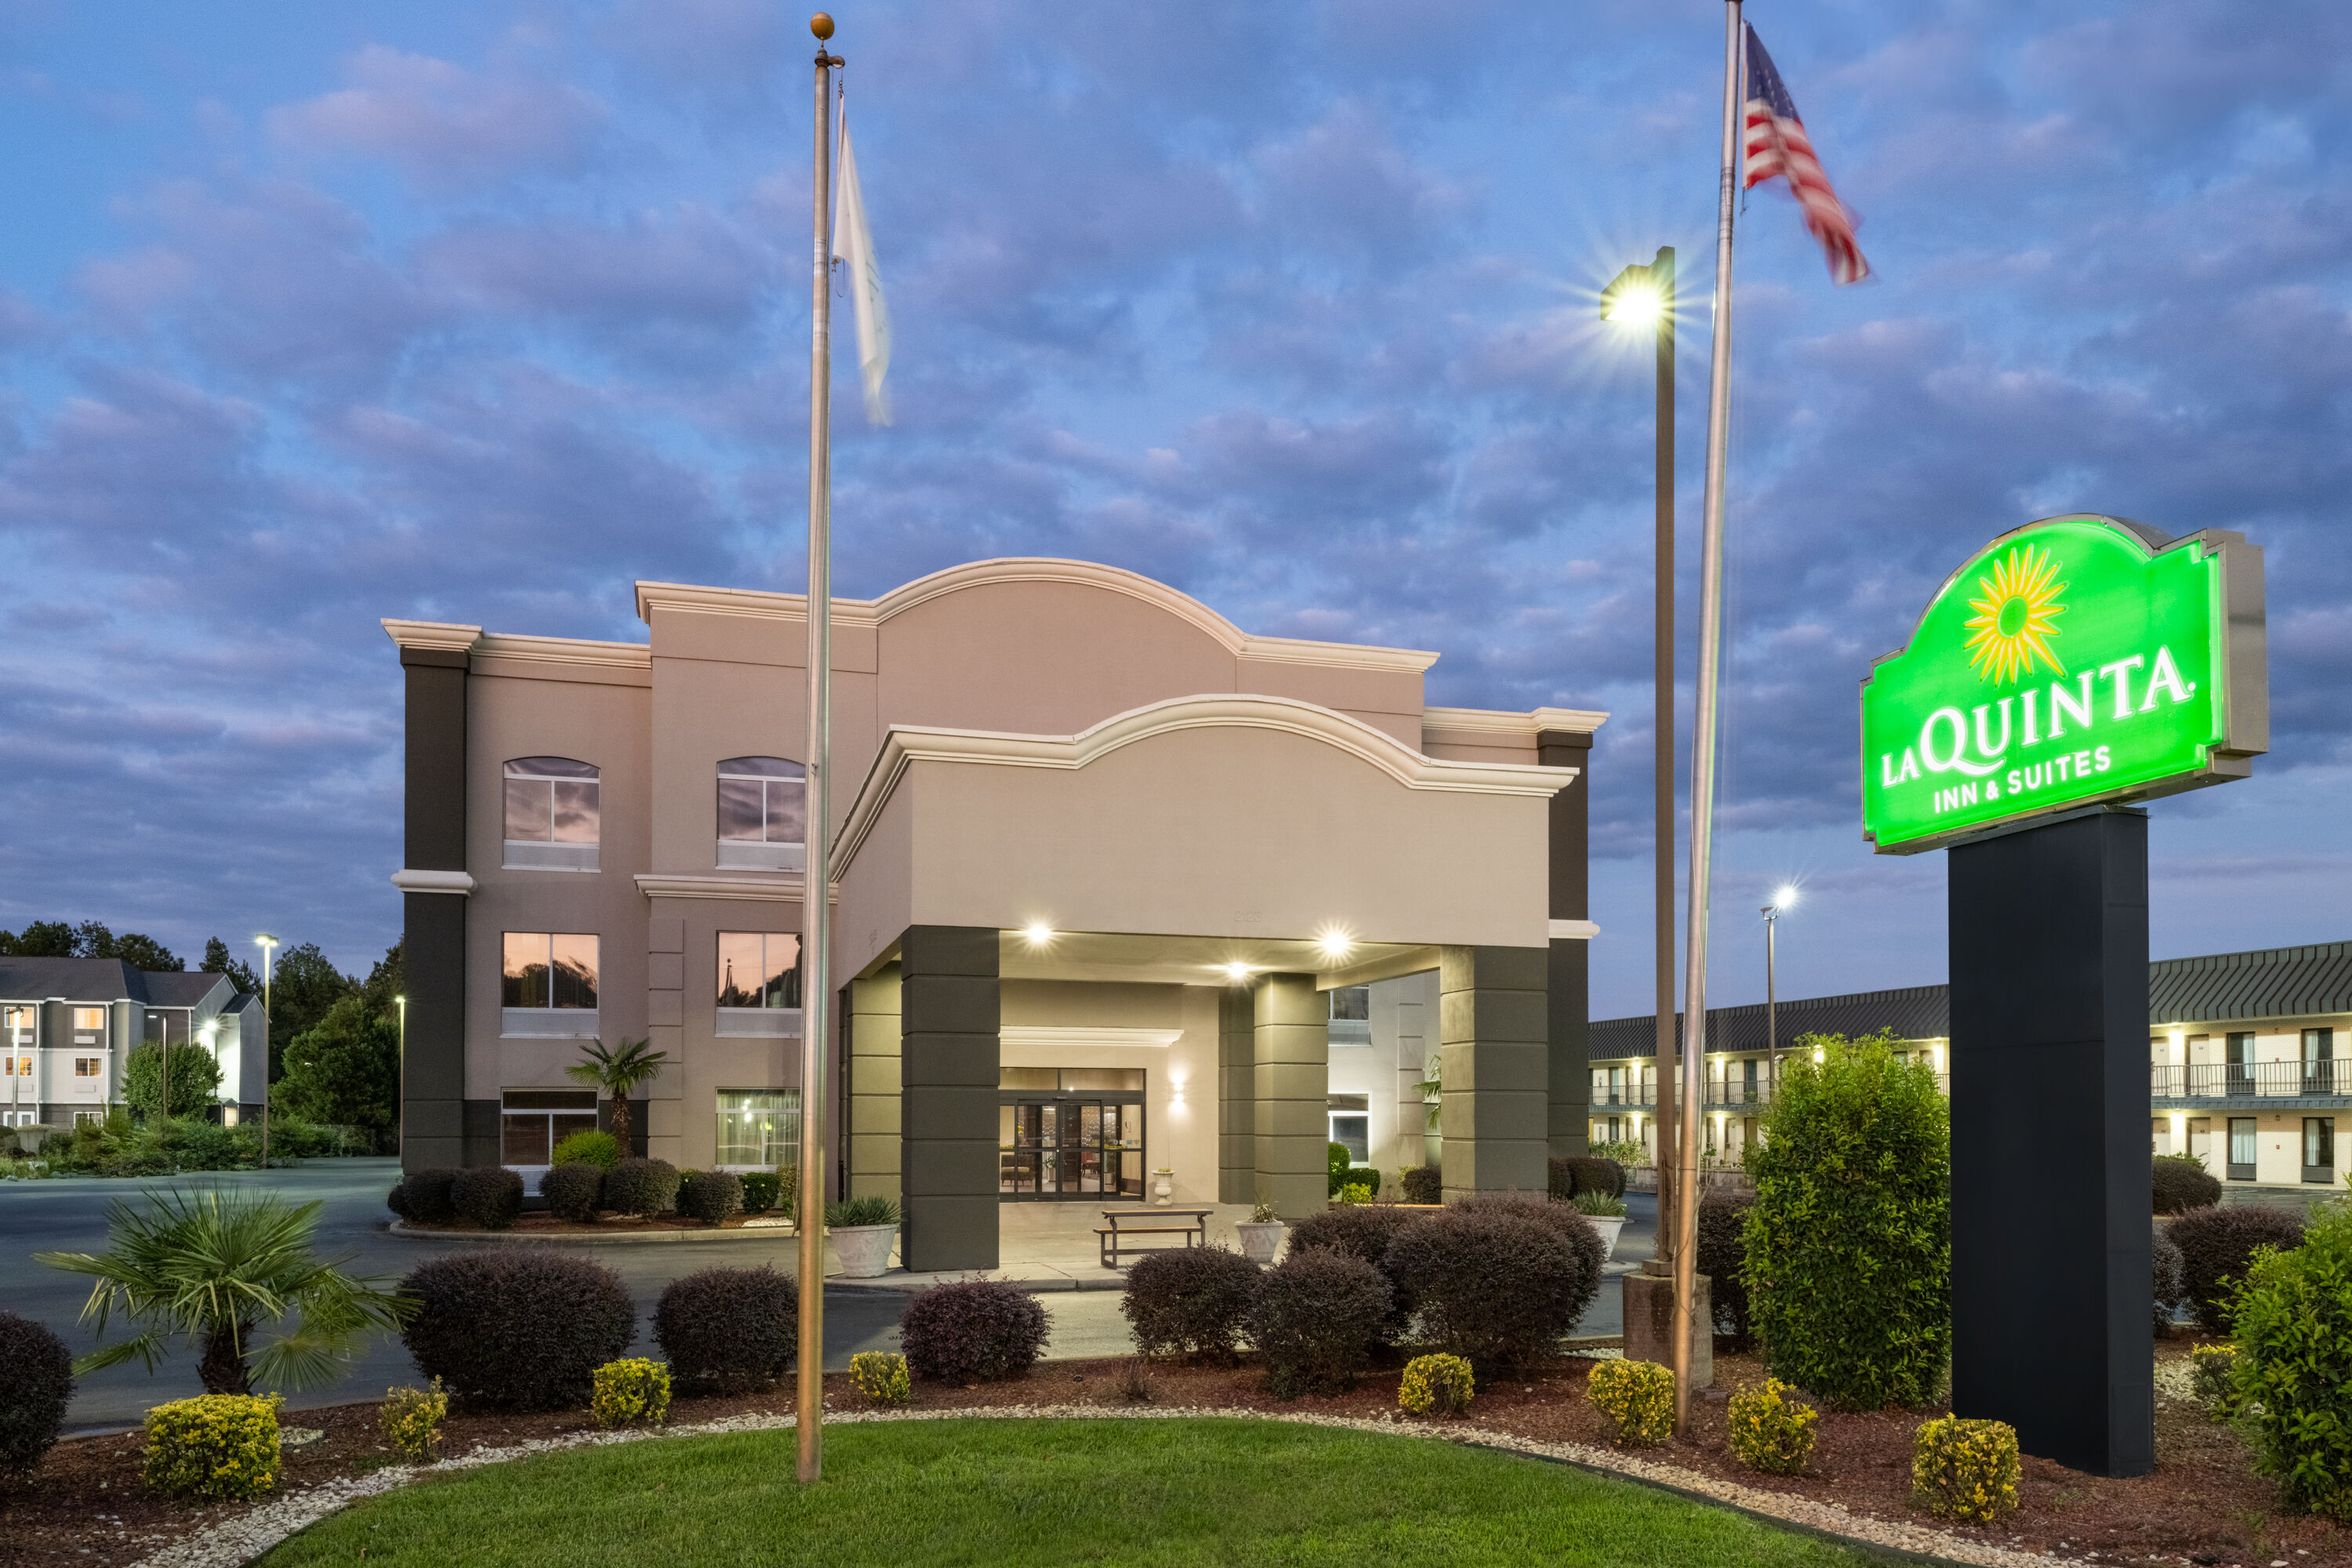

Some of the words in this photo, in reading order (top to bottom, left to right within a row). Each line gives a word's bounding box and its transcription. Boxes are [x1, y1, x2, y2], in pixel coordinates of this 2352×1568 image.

[1881, 747, 1921, 788] LA
[1920, 645, 2193, 776] QUINTA
[1934, 781, 1978, 814] INN
[1985, 779, 2000, 800] &
[2007, 746, 2111, 794] SUITES
